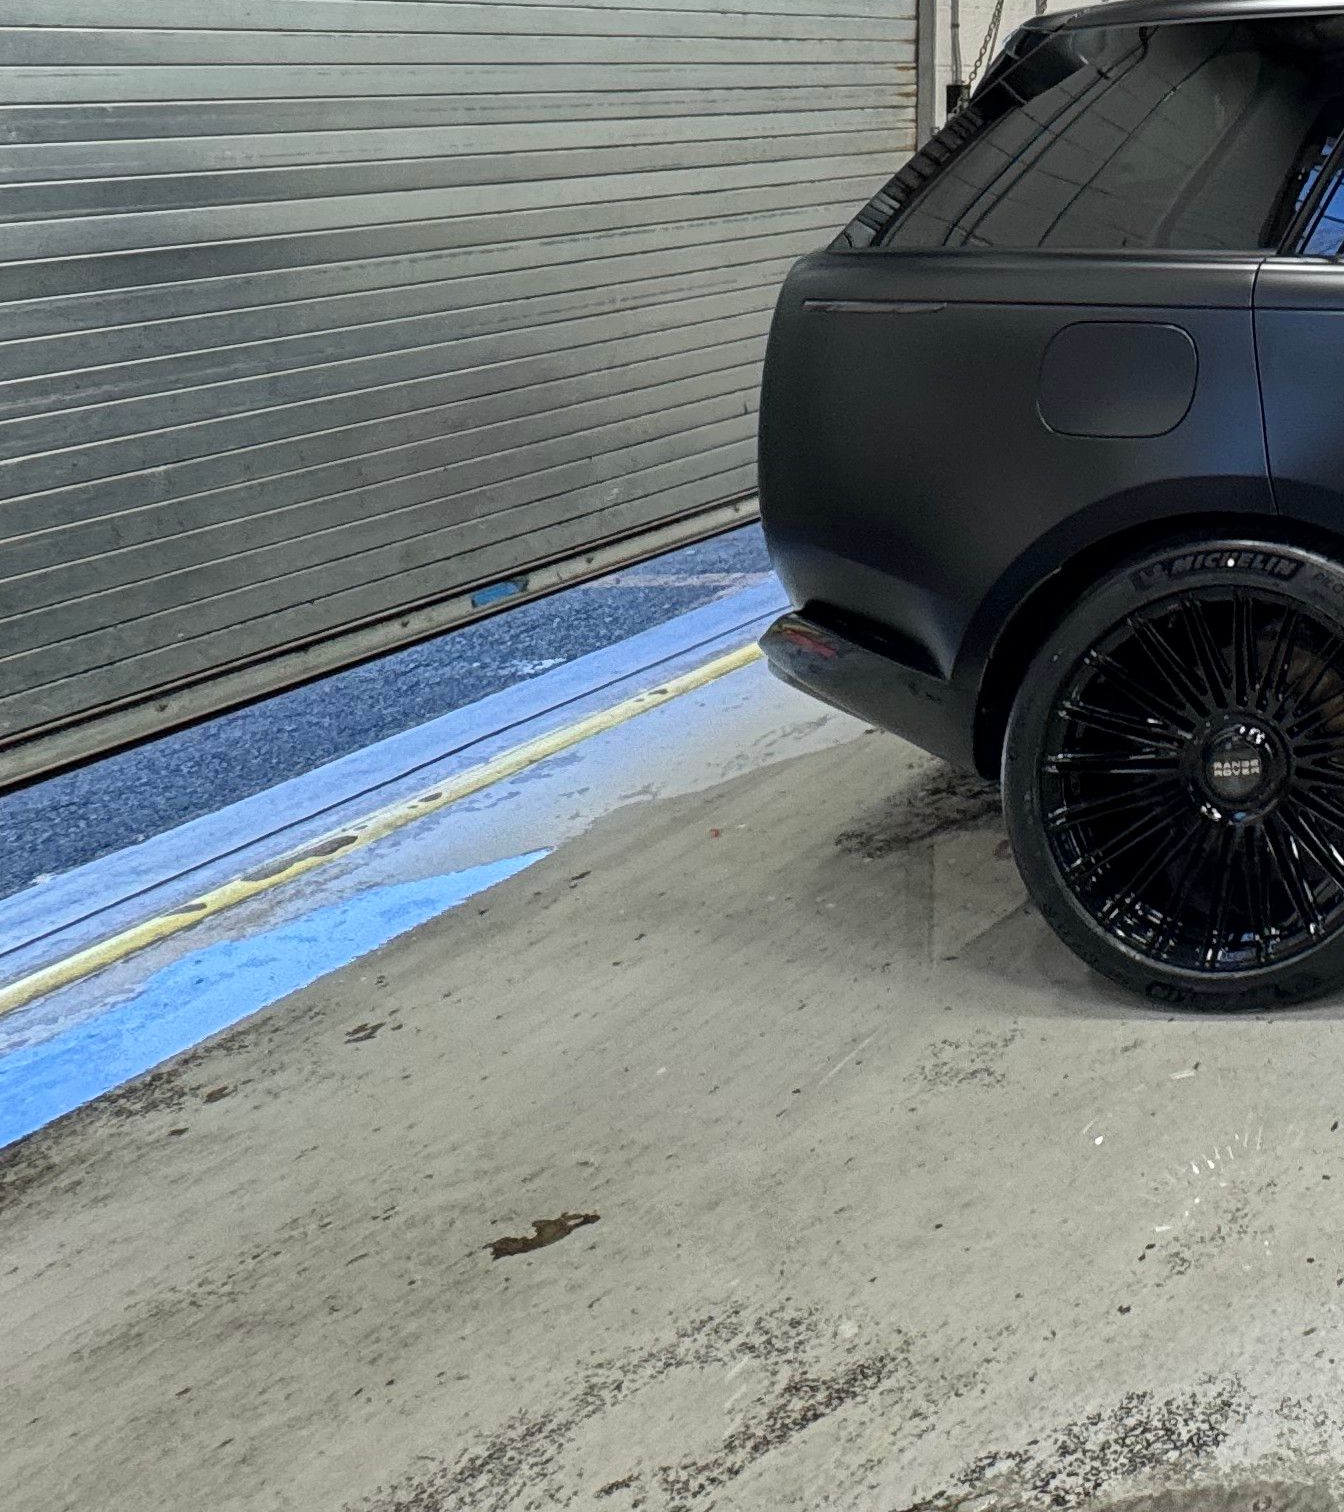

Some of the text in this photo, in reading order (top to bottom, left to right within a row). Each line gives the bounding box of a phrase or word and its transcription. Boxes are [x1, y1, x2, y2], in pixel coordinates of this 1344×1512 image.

[1171, 551, 1296, 577] MICHELIN
[1213, 759, 1260, 770] RANGE
[1213, 767, 1260, 777] ROVER
